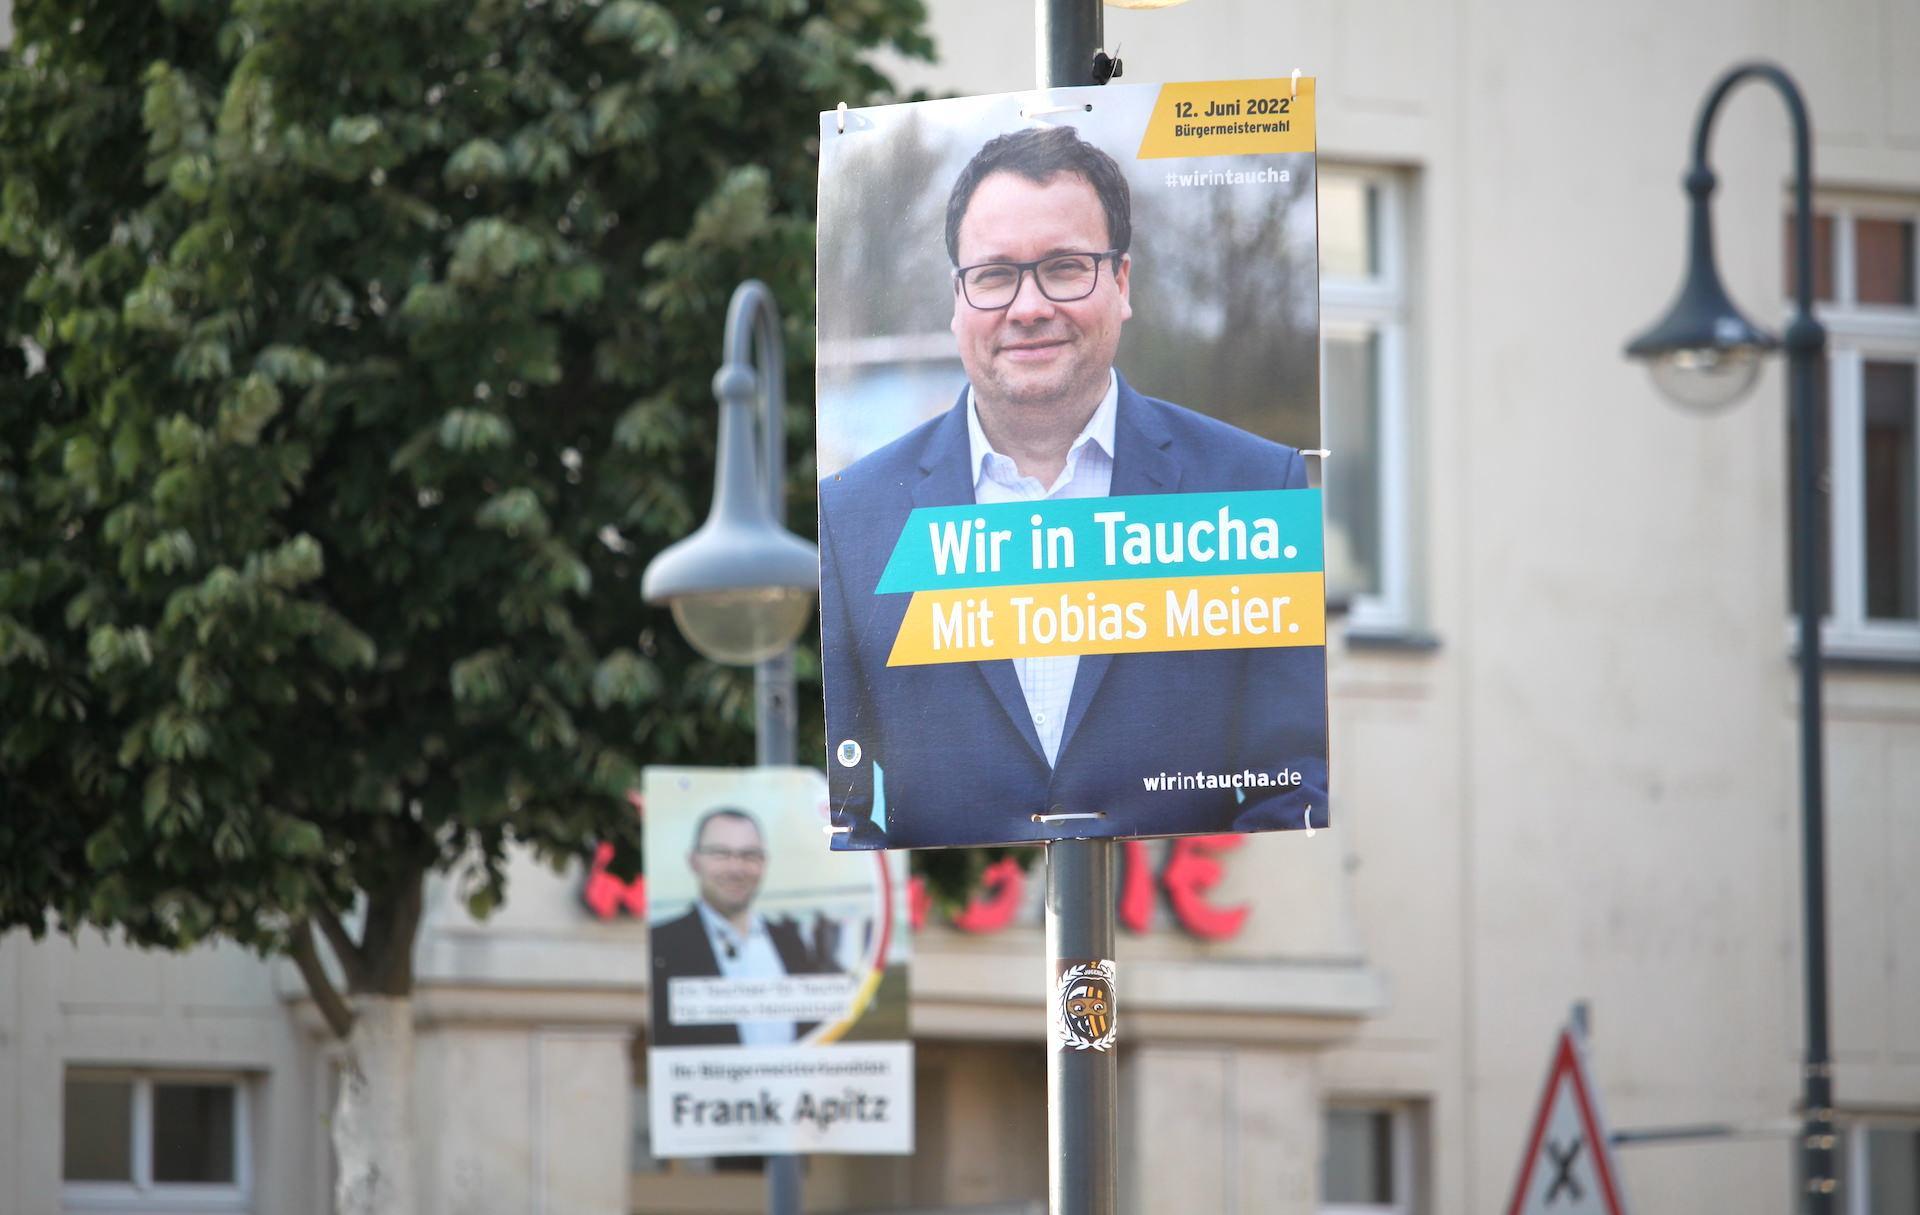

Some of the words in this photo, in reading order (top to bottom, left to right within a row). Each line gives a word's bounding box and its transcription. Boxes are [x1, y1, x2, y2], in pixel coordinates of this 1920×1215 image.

[1174, 102, 1199, 118] 12.
[1204, 100, 1240, 117] Juni
[1246, 98, 1290, 115] 2022
[1174, 120, 1290, 138] Bürgermeisterwahl
[1165, 167, 1291, 187] #wirintaucha
[929, 517, 1012, 576] Wir
[1031, 514, 1075, 570] in
[1094, 505, 1298, 566] Taucha.
[931, 598, 994, 651] Mit
[1010, 593, 1147, 646] Tobias
[1165, 585, 1299, 638] Meier.
[1143, 768, 1302, 791] wirintaucha.de
[672, 1089, 782, 1126] Frank
[794, 1086, 889, 1132] Apitz
